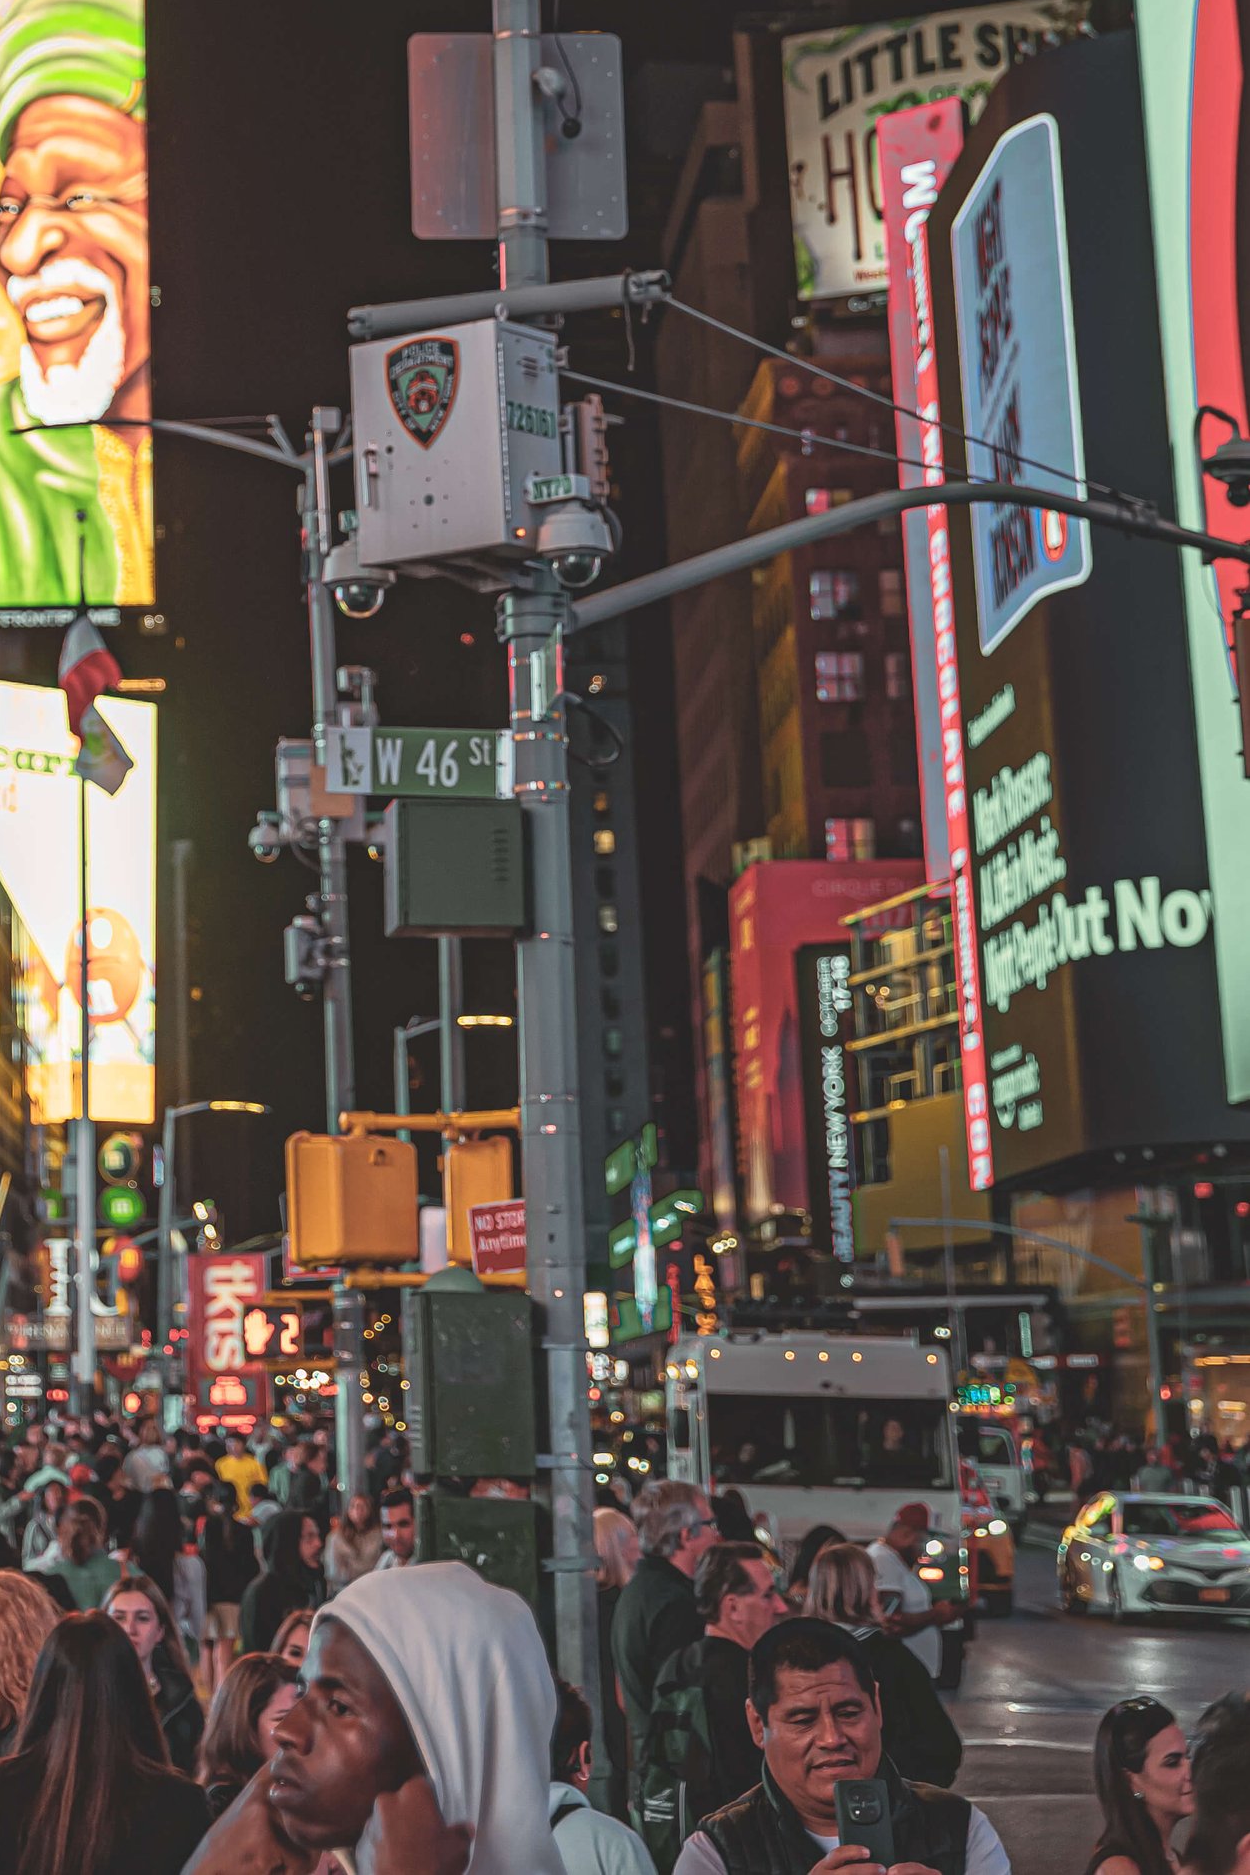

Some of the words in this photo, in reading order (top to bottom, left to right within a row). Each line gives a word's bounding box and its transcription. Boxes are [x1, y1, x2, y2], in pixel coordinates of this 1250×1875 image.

[816, 24, 964, 122] LITTLE
[375, 737, 403, 786] W
[415, 738, 460, 788] 46
[468, 735, 492, 767] St
[475, 1213, 495, 1232] NO
[495, 1209, 526, 1231] STOP
[478, 1231, 527, 1255] Anytim
[203, 1259, 257, 1372] tkts
[280, 1313, 300, 1355] 2
